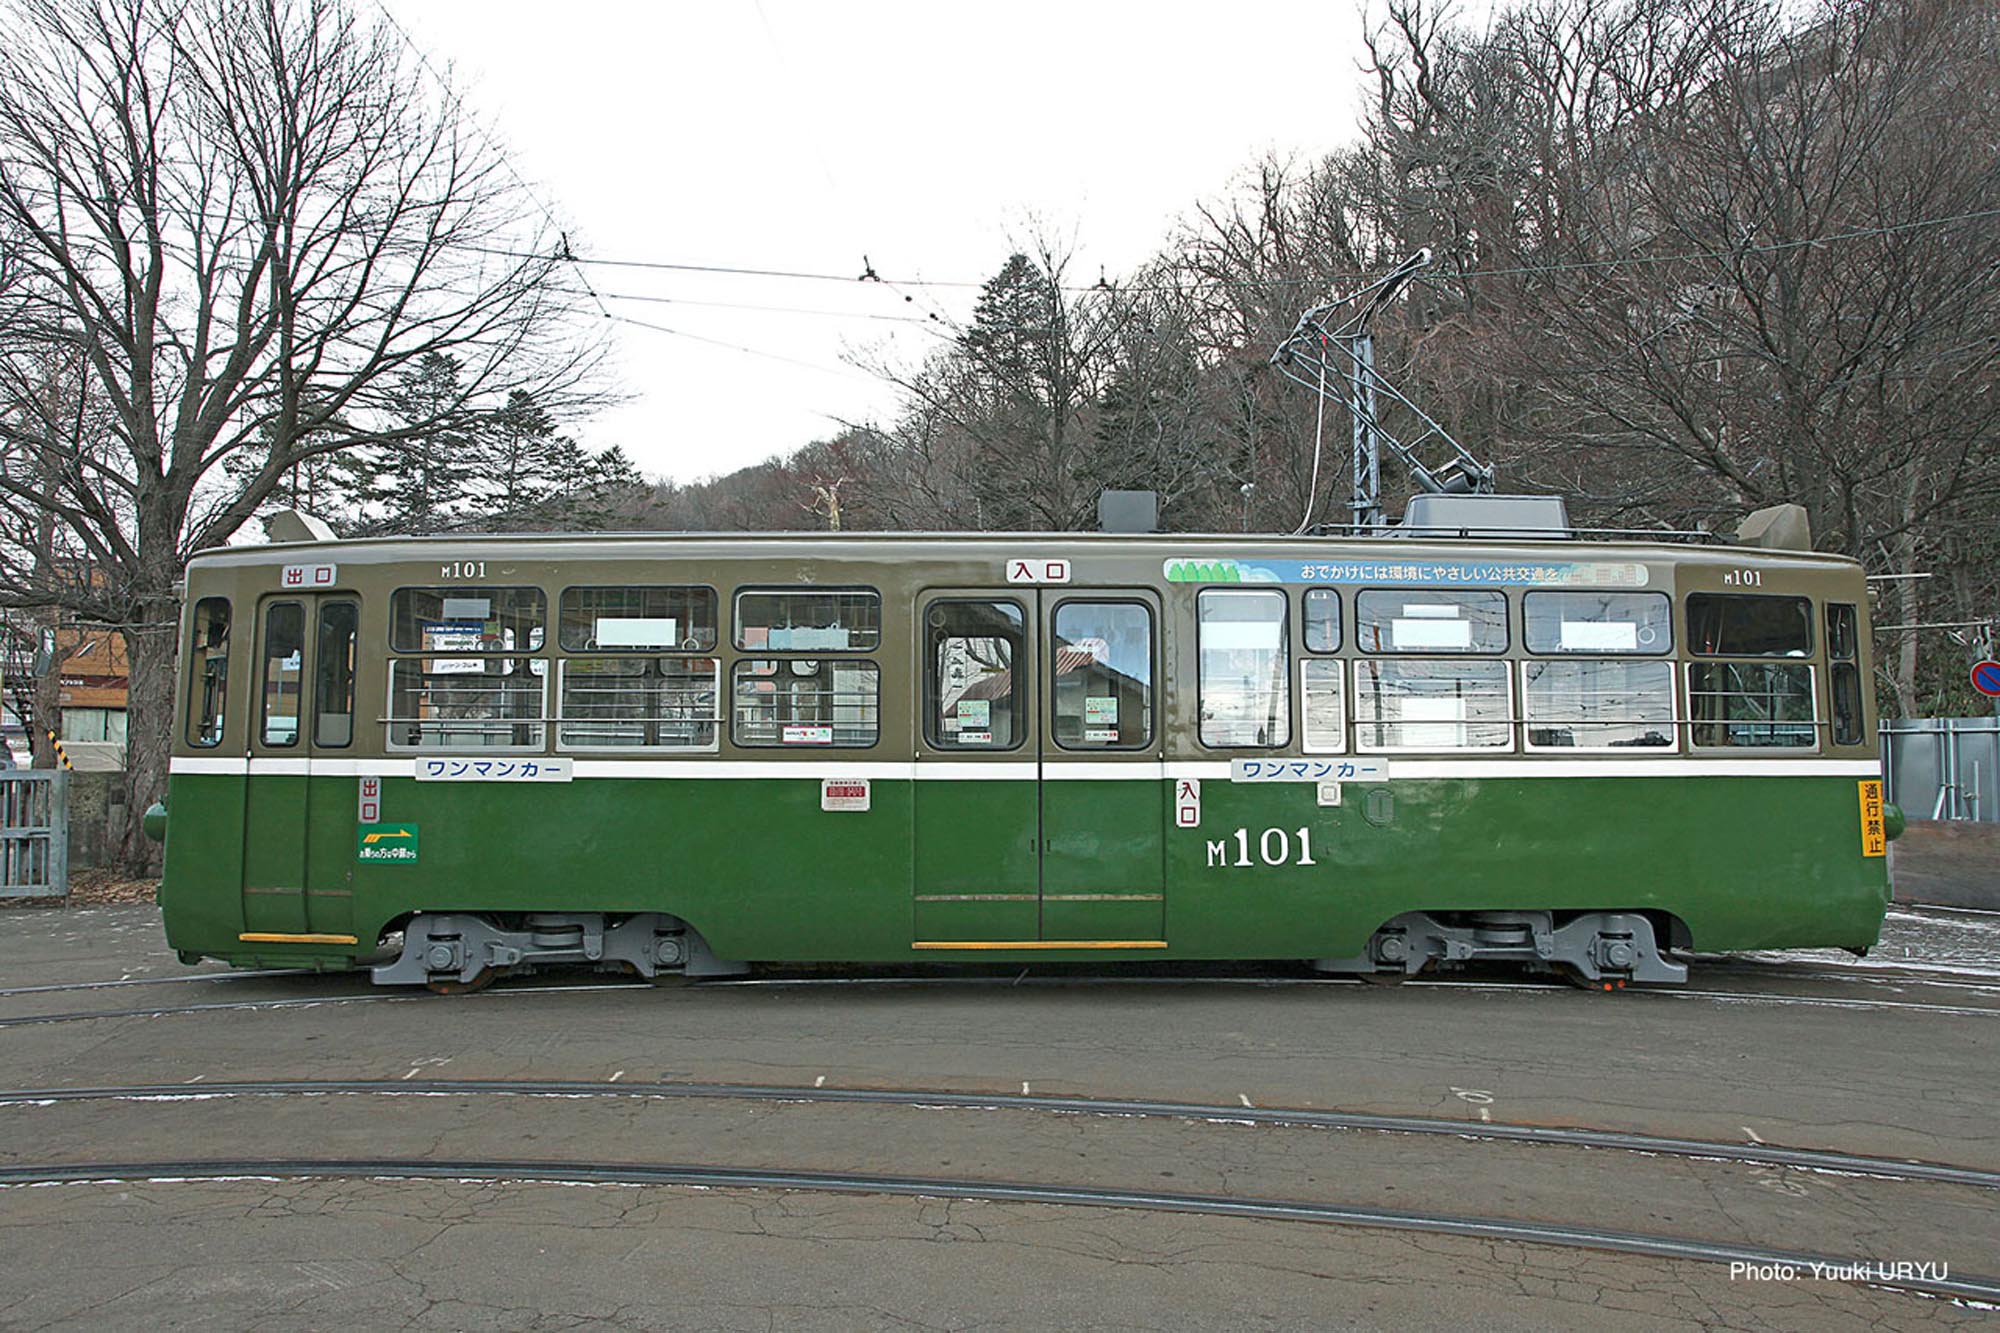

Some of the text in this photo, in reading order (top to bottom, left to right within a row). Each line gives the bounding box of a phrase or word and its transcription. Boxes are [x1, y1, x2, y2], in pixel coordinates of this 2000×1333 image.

[287, 568, 332, 584] 出口
[441, 561, 487, 579] M101
[1013, 562, 1065, 580] 入口
[1301, 564, 1560, 582] おでかけには環境にやさしい公共交通を
[1724, 570, 1762, 587] M101
[427, 761, 561, 777] ワンマンカー
[1243, 762, 1377, 778] ワンマンカー
[363, 779, 377, 820] 出口
[1180, 782, 1196, 824] 入口
[1864, 783, 1882, 853] 通行禁止
[1206, 827, 1316, 867] M101
